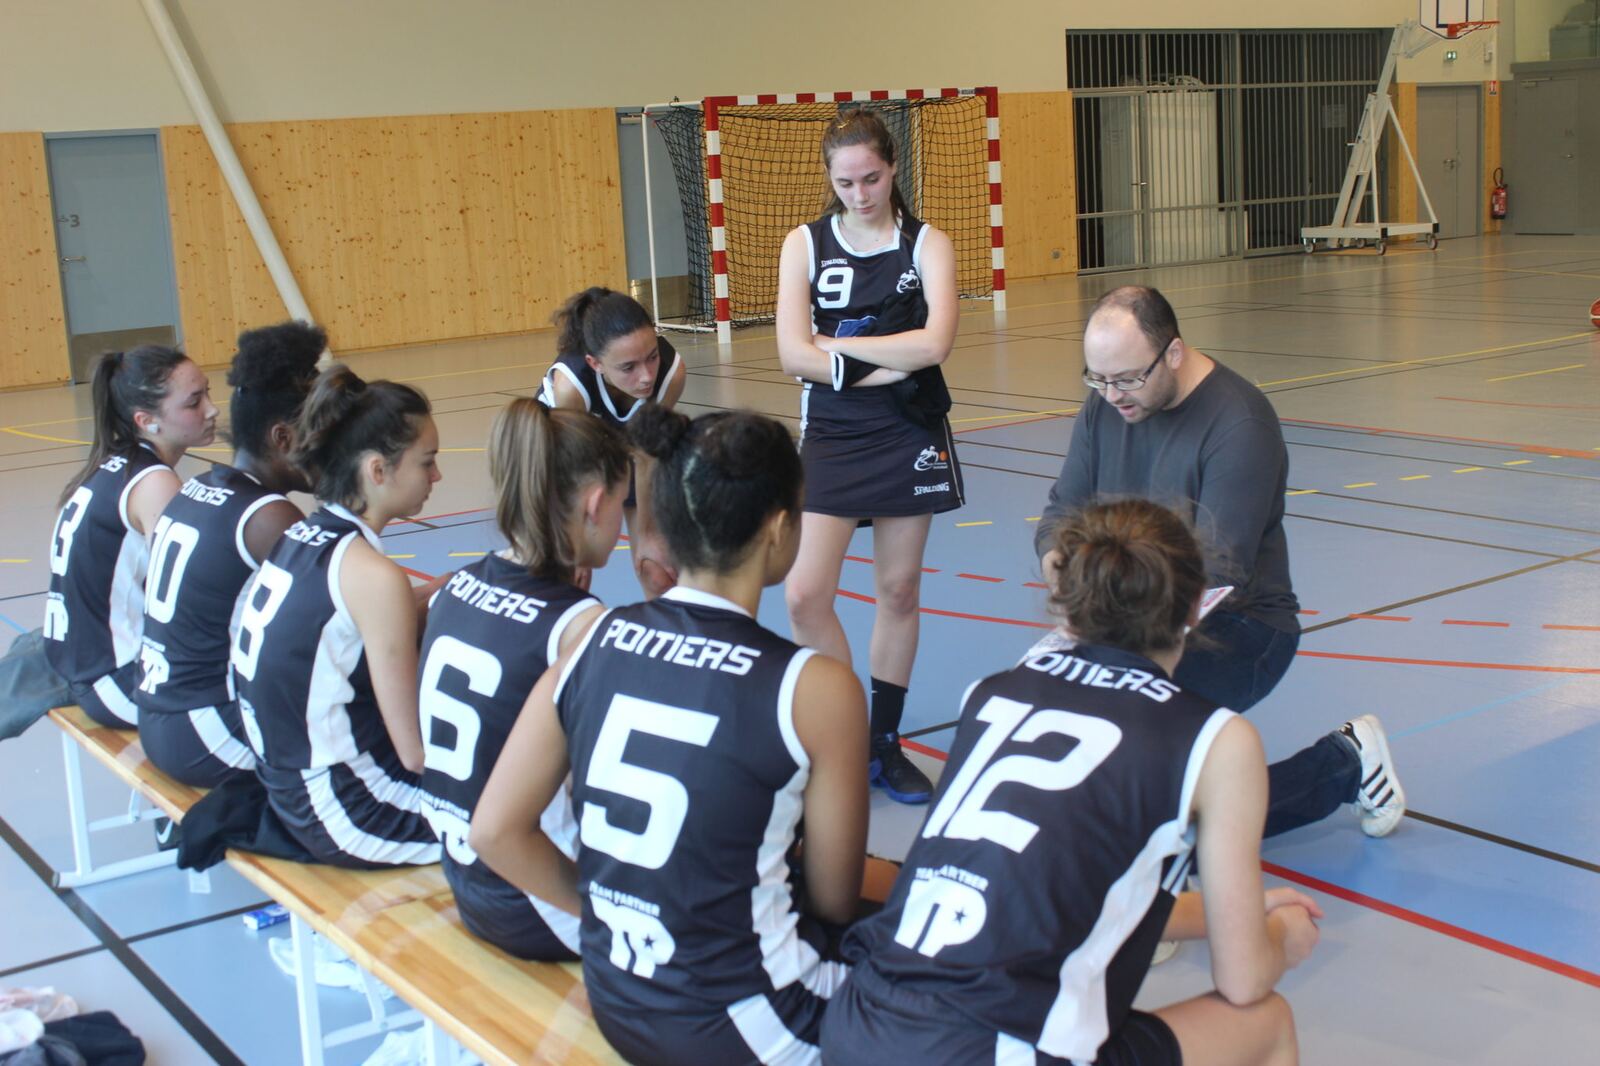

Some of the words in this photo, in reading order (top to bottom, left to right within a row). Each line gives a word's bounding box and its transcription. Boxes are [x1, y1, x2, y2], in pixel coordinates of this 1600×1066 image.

[70, 214, 80, 228] 3
[817, 267, 854, 309] 9
[914, 482, 949, 496] SPALDING
[50, 486, 93, 577] 3
[144, 515, 200, 624] 10
[445, 570, 548, 624] POITIERS
[231, 559, 293, 682] 8
[600, 618, 762, 676] POITIERS
[1025, 652, 1182, 703] OITIERS
[418, 634, 502, 781] 6
[580, 693, 720, 870] 5
[922, 695, 1123, 854] 12
[939, 863, 990, 892] ARTNER
